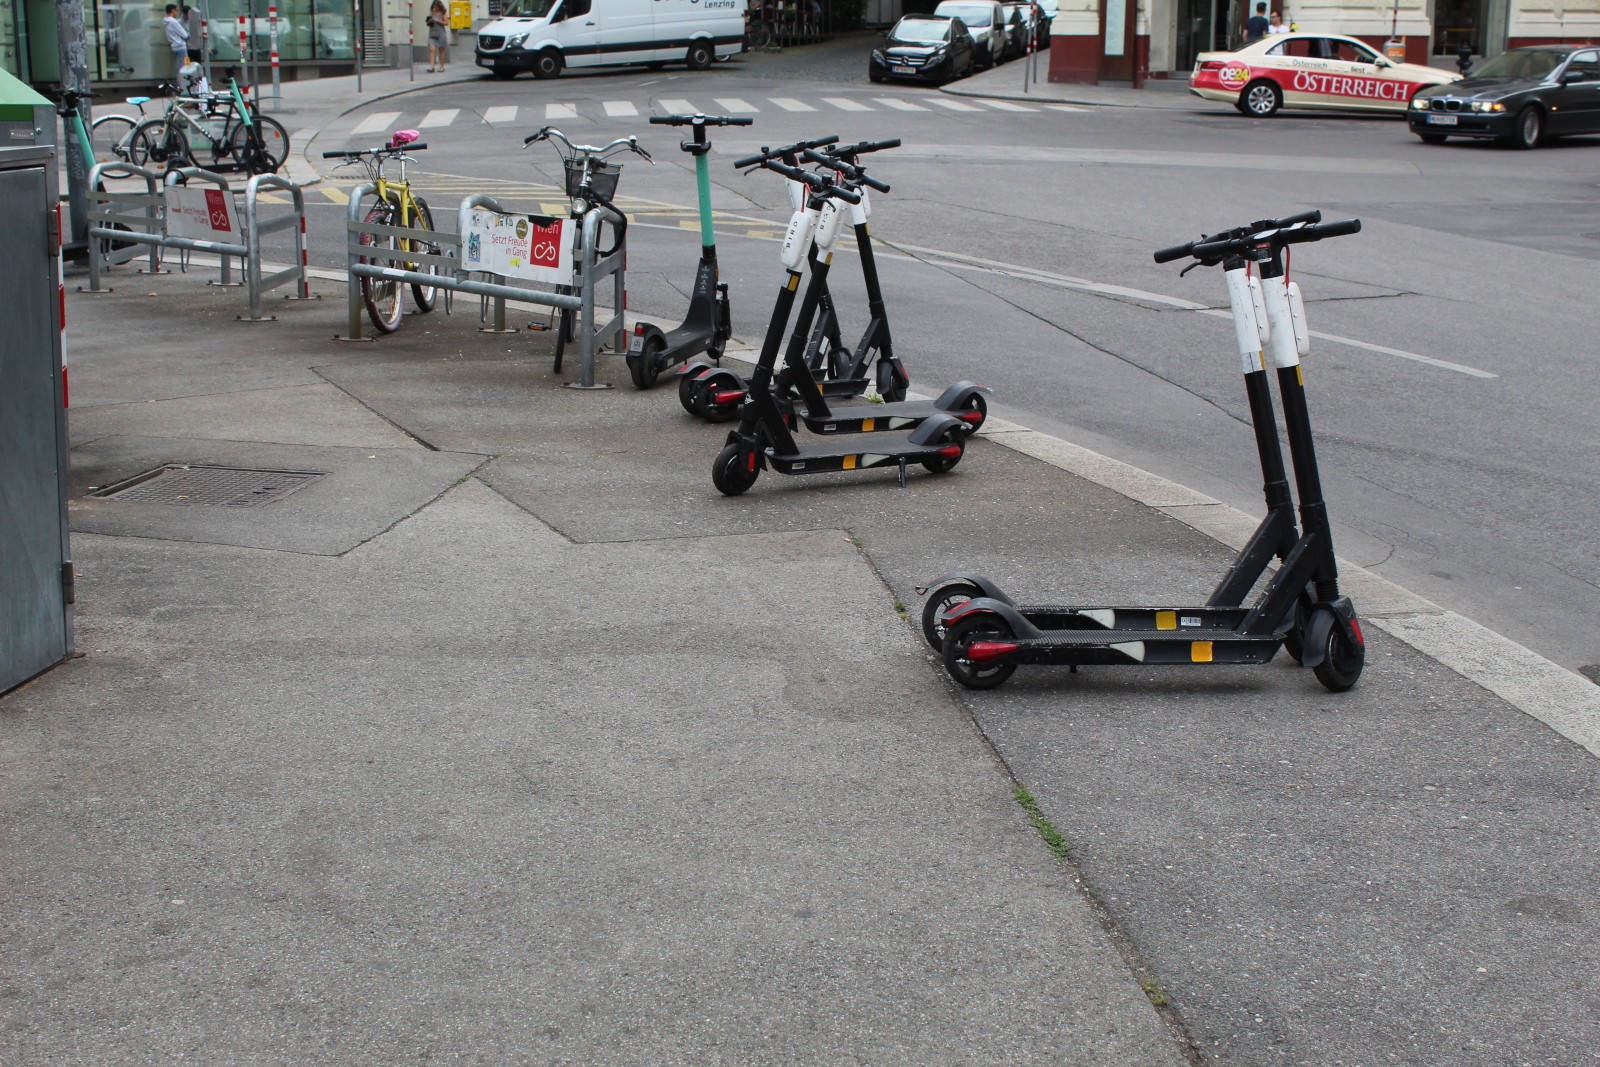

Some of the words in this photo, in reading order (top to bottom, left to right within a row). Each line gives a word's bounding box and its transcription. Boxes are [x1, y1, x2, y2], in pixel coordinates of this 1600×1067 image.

[704, 0, 735, 8] Lenzing
[1292, 59, 1328, 69] Österreich
[1351, 66, 1365, 74] liest
[1220, 67, 1249, 81] oe24
[1293, 70, 1408, 100] ÖSTERREICH
[207, 192, 223, 205] Wien
[193, 208, 207, 217] Freude
[198, 216, 210, 227] Gang
[491, 234, 507, 245] Setzt
[508, 236, 528, 248] Freude
[786, 221, 798, 249] BIRD
[506, 247, 511, 255] in
[513, 247, 527, 259] Gang
